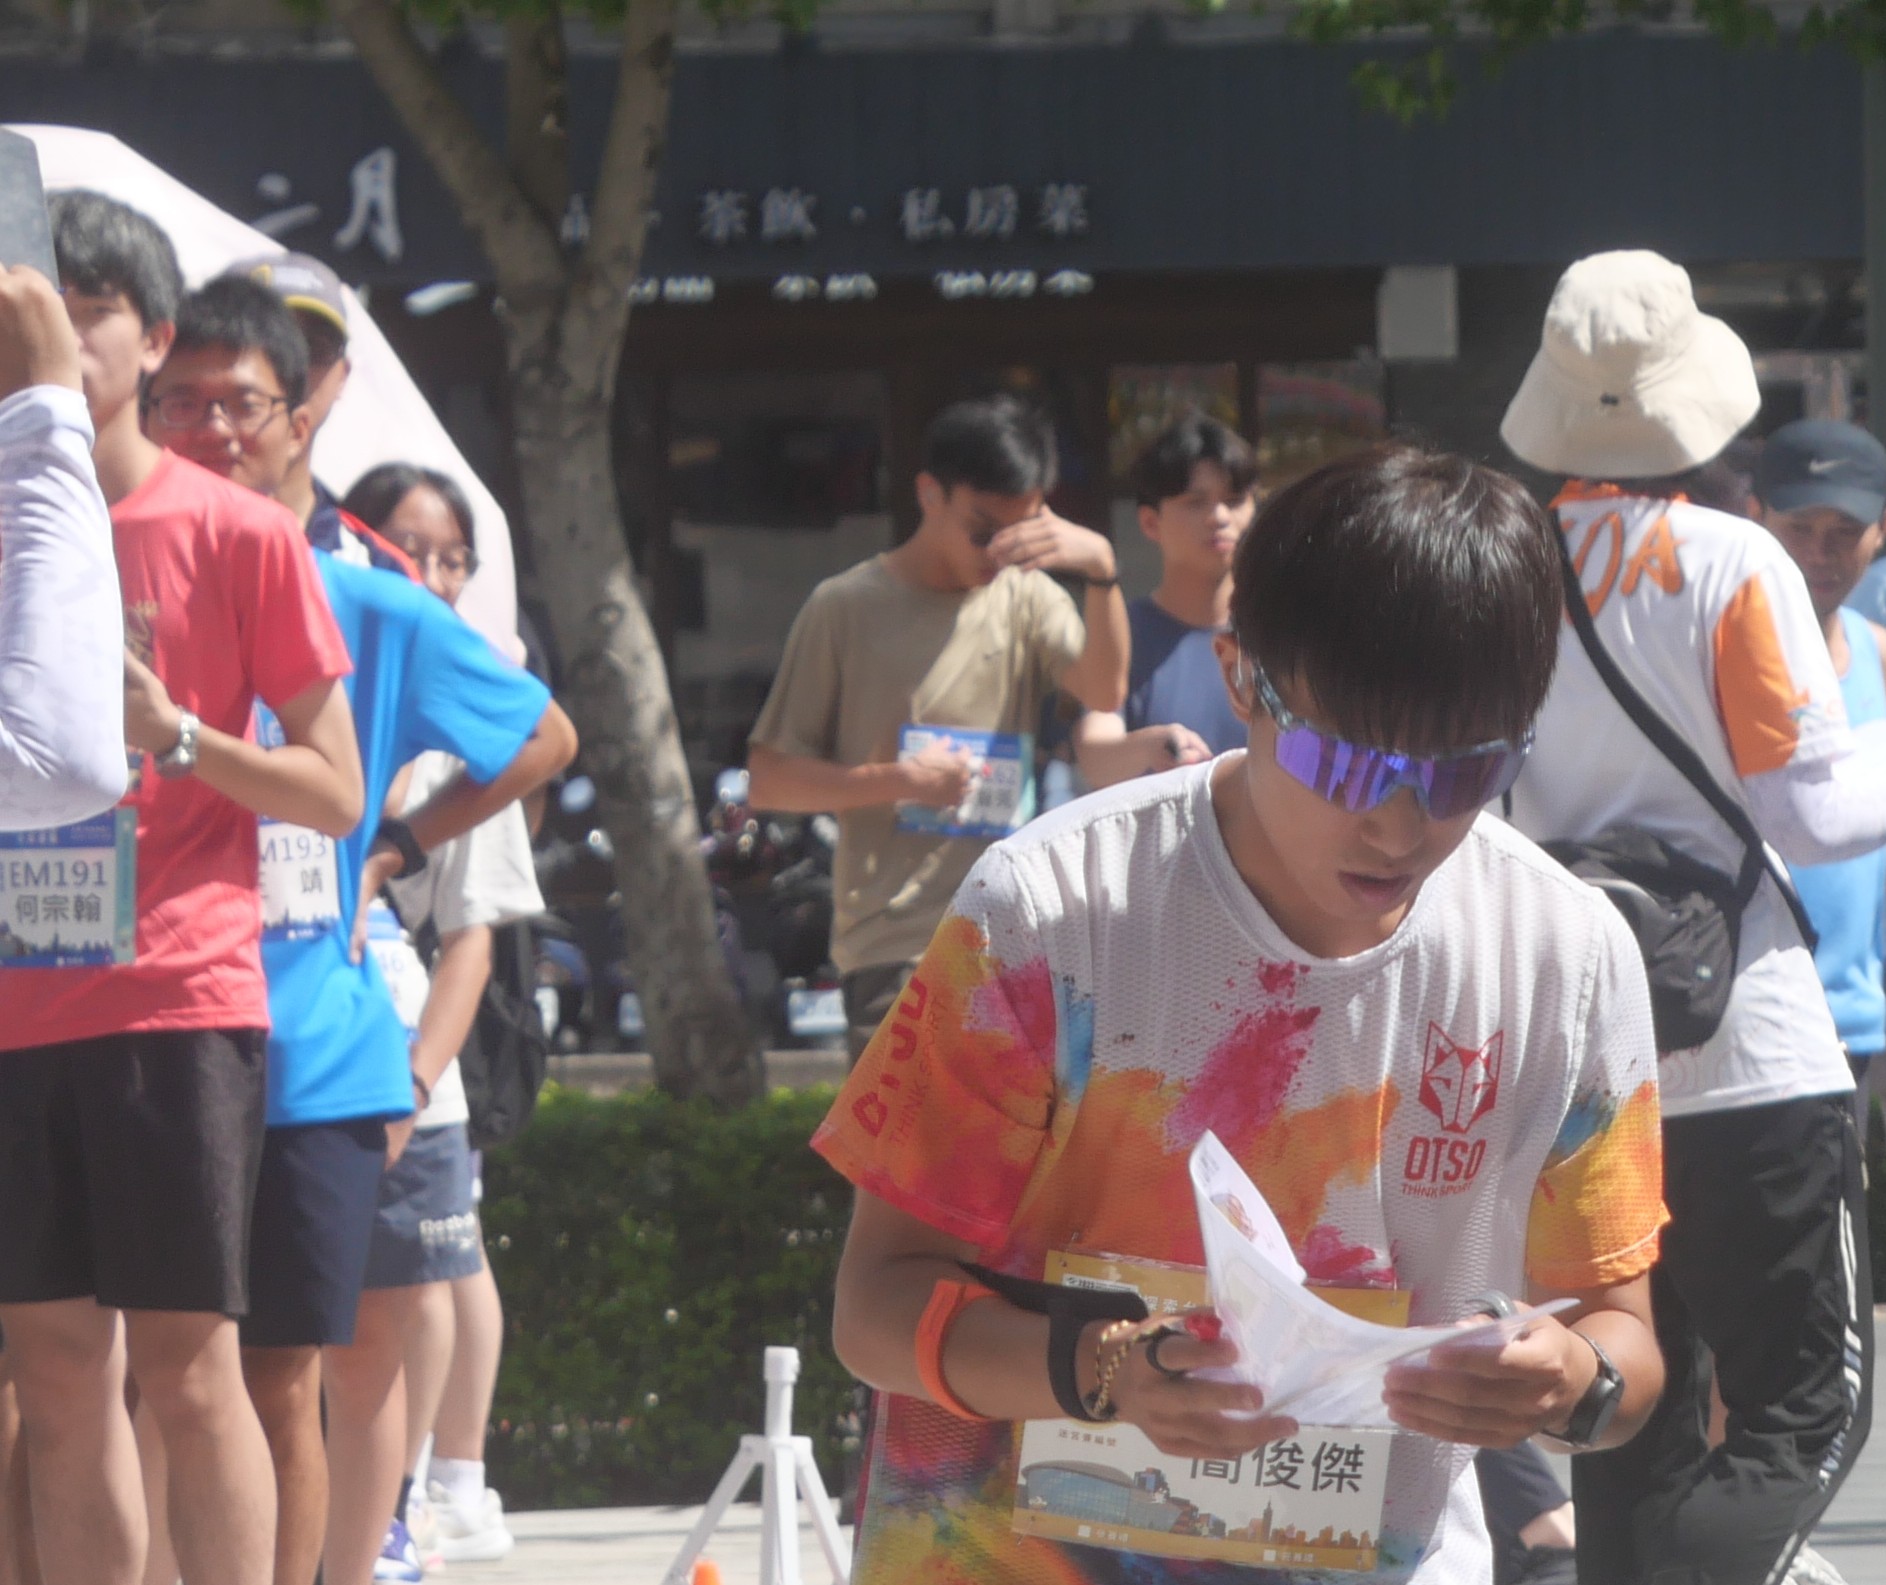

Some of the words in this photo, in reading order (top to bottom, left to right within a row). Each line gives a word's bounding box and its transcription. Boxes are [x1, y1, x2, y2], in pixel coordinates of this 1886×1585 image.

[10, 859, 107, 888] EM191
[16, 892, 102, 924] 何宗翰
[1404, 1136, 1487, 1183] OTSO
[1402, 1182, 1438, 1199] THINK
